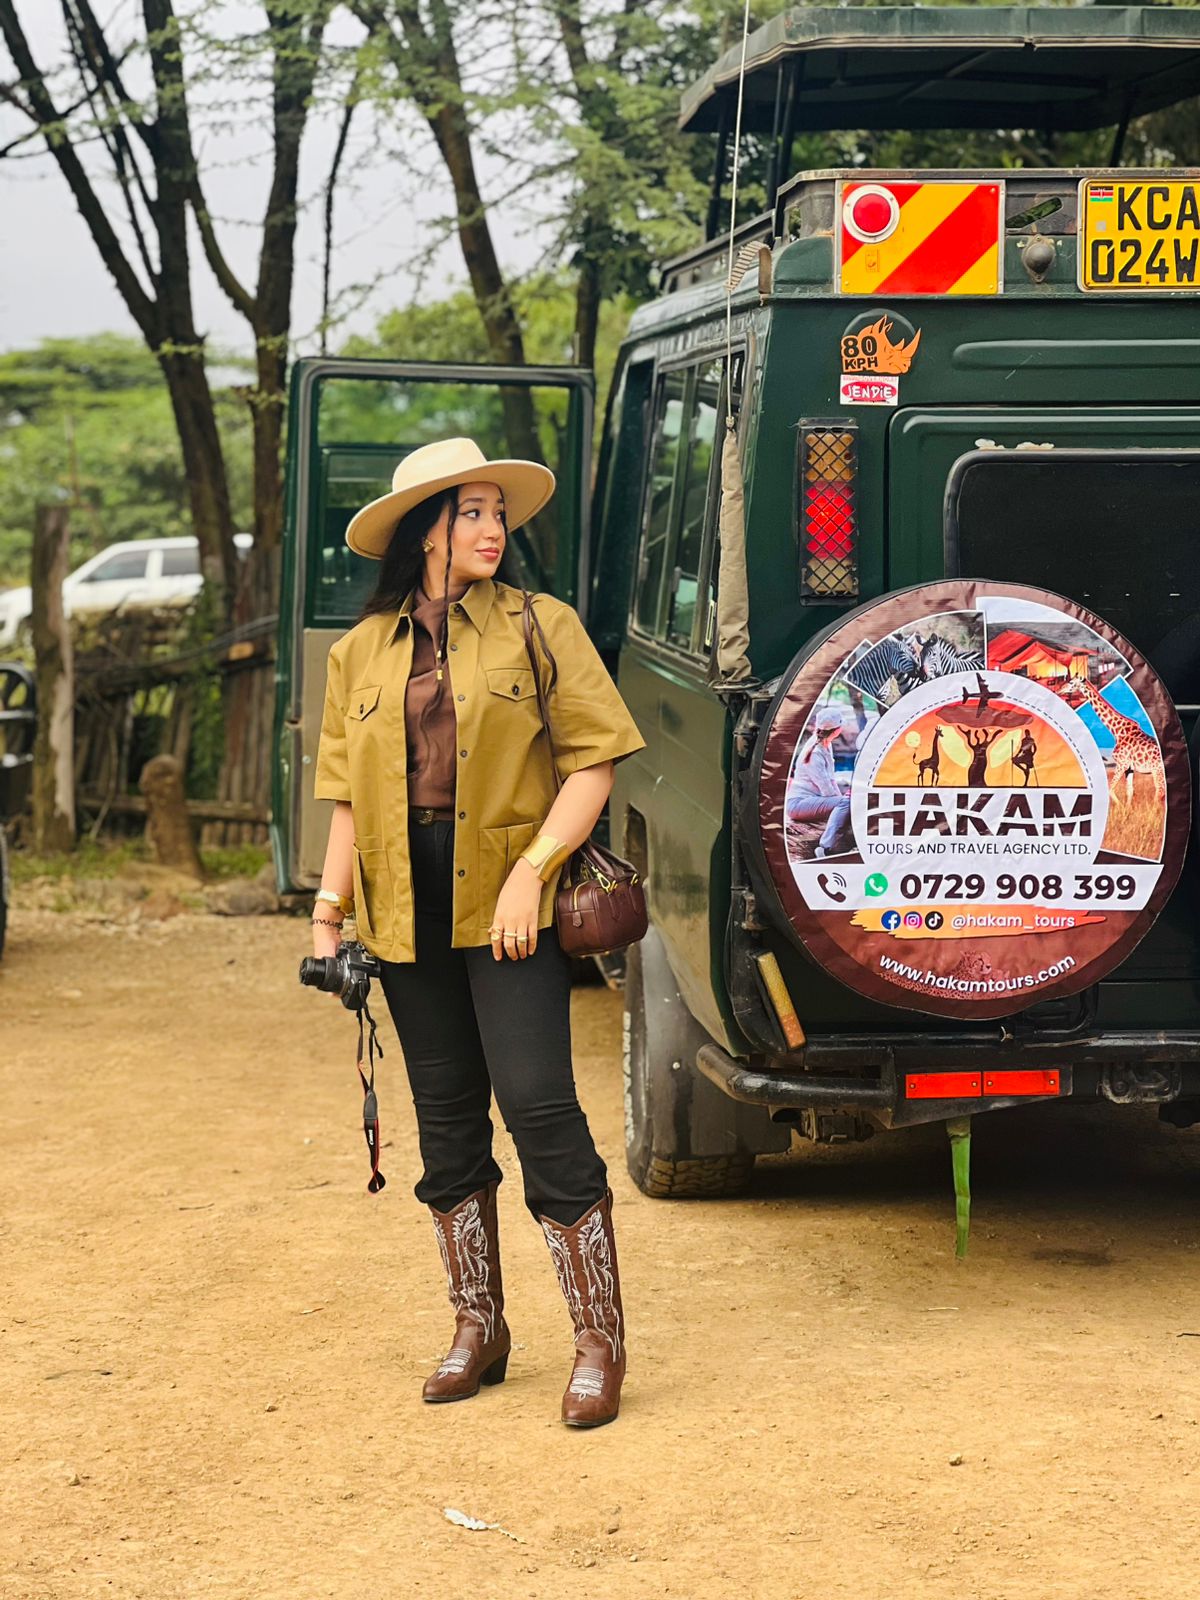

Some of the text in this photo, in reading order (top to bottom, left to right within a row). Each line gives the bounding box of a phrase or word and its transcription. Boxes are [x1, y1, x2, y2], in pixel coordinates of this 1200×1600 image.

[1118, 186, 1200, 231] KCA
[1091, 238, 1199, 283] 024W
[842, 336, 878, 358] 80
[844, 357, 879, 371] KPH
[866, 792, 1093, 837] HAKAM
[867, 843, 1092, 856] TOURS AND TRAVEL AGENCY LTD.
[900, 874, 1136, 900] 0729 908 399
[951, 913, 1075, 930] @hakam_tours
[879, 953, 1076, 993] www.hakamtours.com
